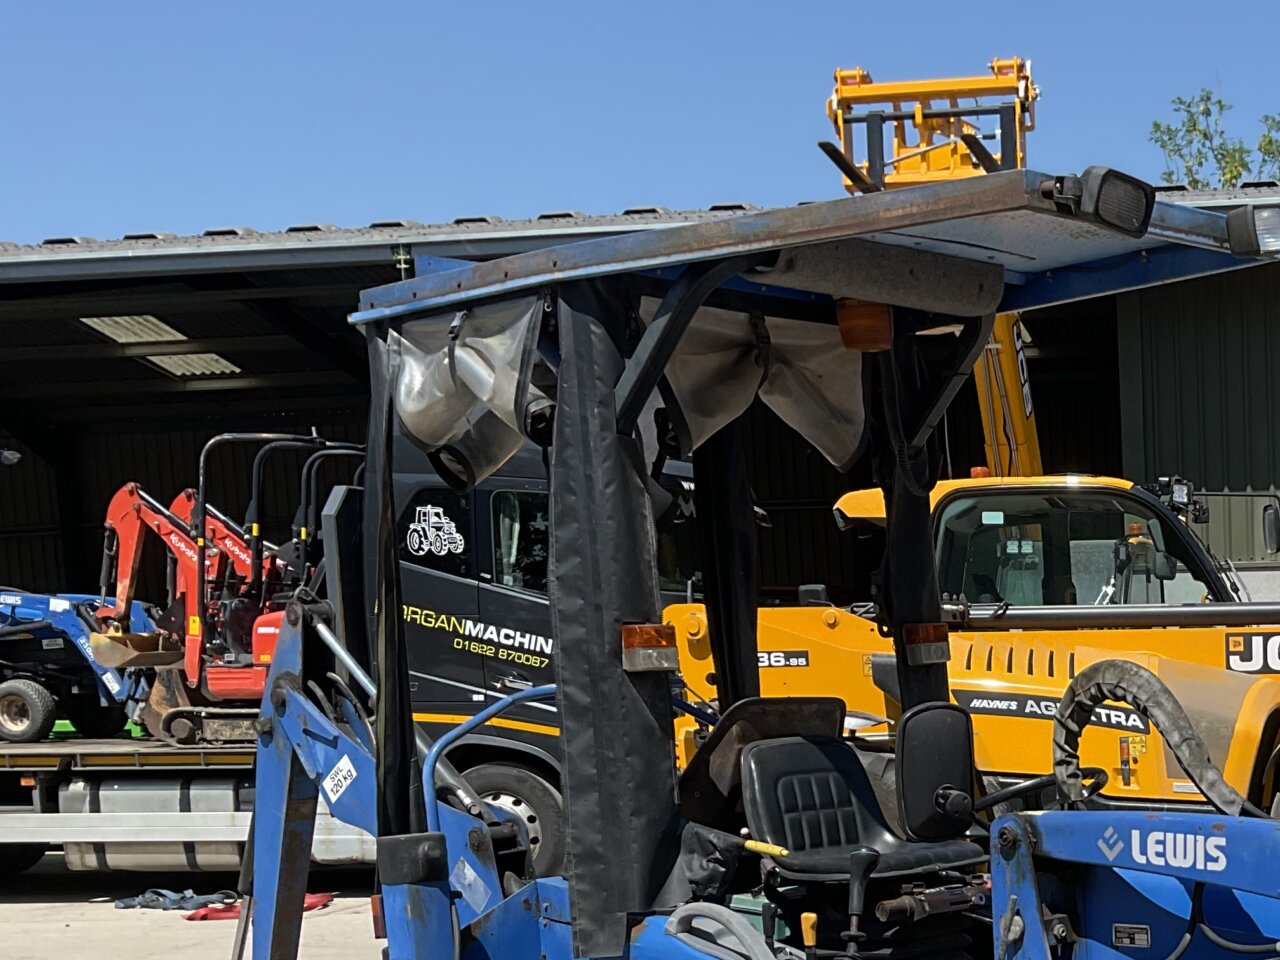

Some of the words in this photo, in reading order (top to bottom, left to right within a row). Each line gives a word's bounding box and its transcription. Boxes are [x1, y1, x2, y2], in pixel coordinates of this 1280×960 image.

[169, 533, 198, 562] Kubota
[224, 538, 251, 565] Kubota
[0, 595, 22, 605] EWIS
[453, 638, 495, 657] 01622
[498, 649, 549, 668] 870087
[970, 699, 1018, 710] HAYNES
[1024, 699, 1060, 716] AG
[1090, 708, 1145, 729] TRA
[330, 766, 344, 782] SWL
[330, 778, 344, 796] 120
[341, 769, 354, 782] kg
[1131, 829, 1227, 872] LEWIS
